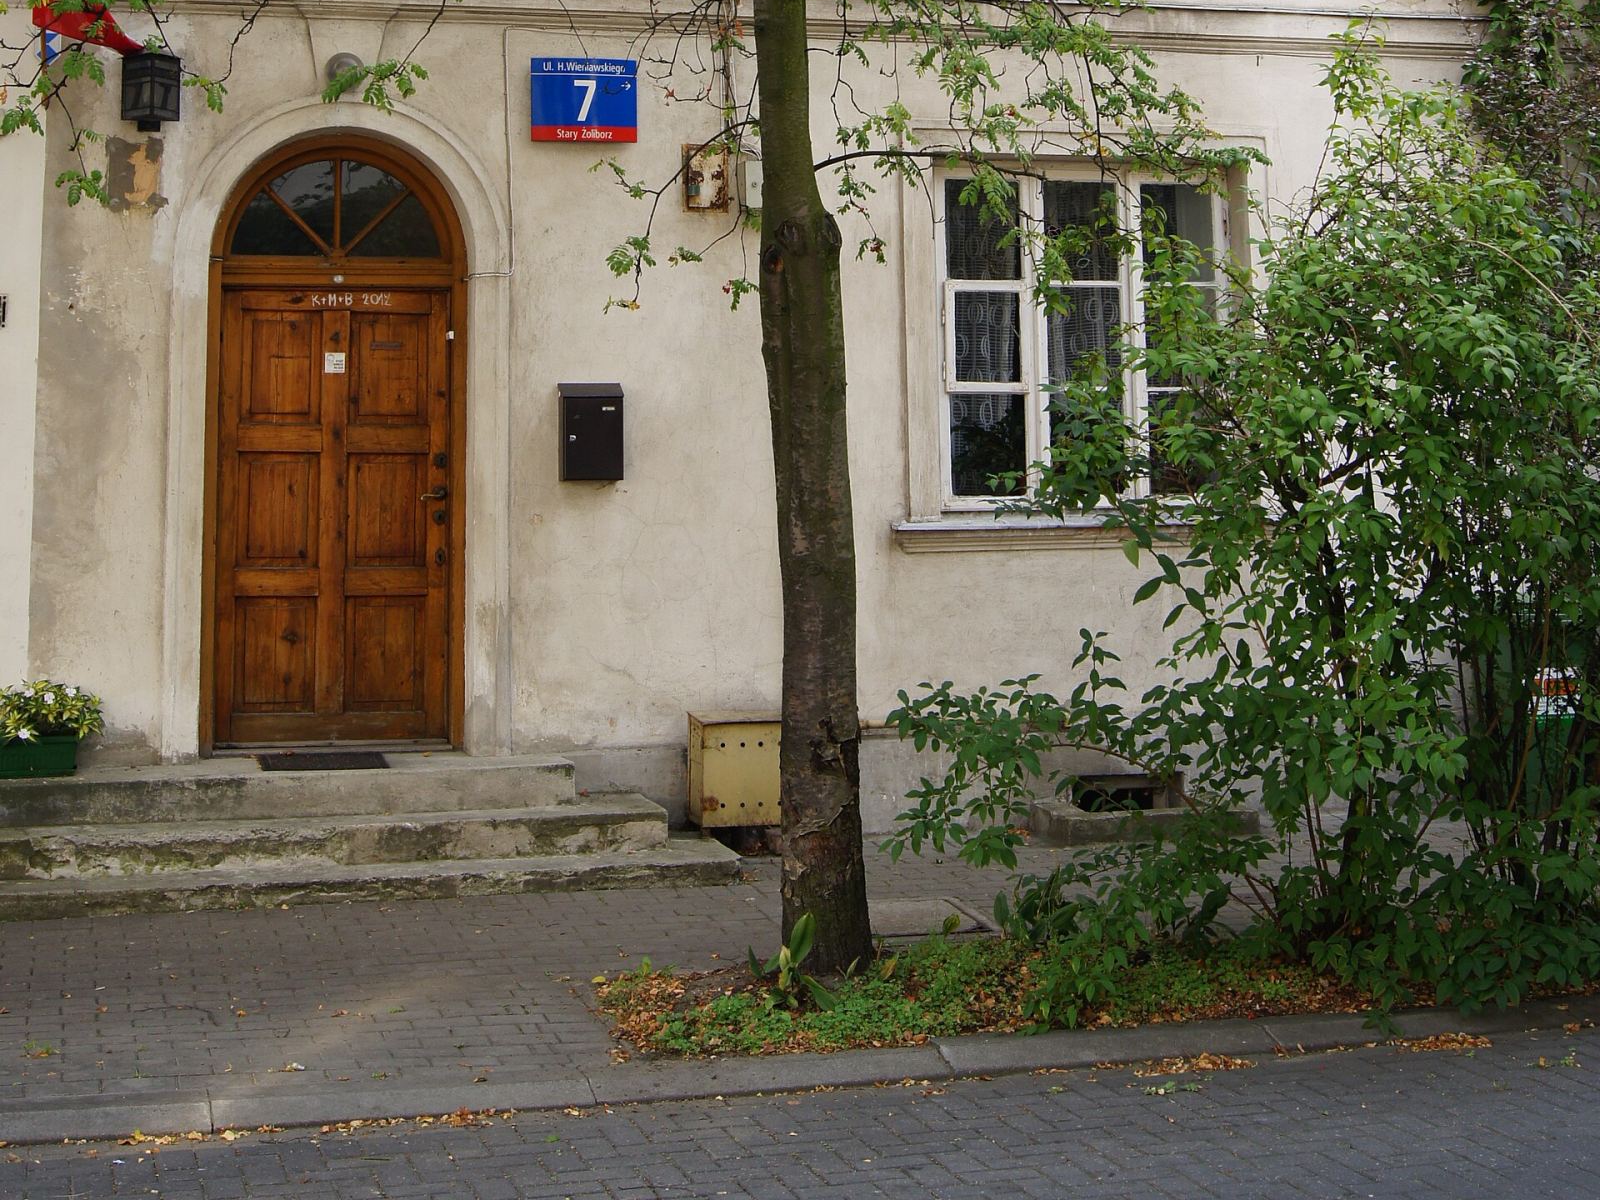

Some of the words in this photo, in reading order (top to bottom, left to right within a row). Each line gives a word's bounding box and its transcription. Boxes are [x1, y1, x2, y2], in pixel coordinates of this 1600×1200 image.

[543, 61, 554, 71] Ul.
[573, 79, 597, 121] 7
[556, 128, 578, 141] Stary
[581, 126, 613, 139] Żoliborz
